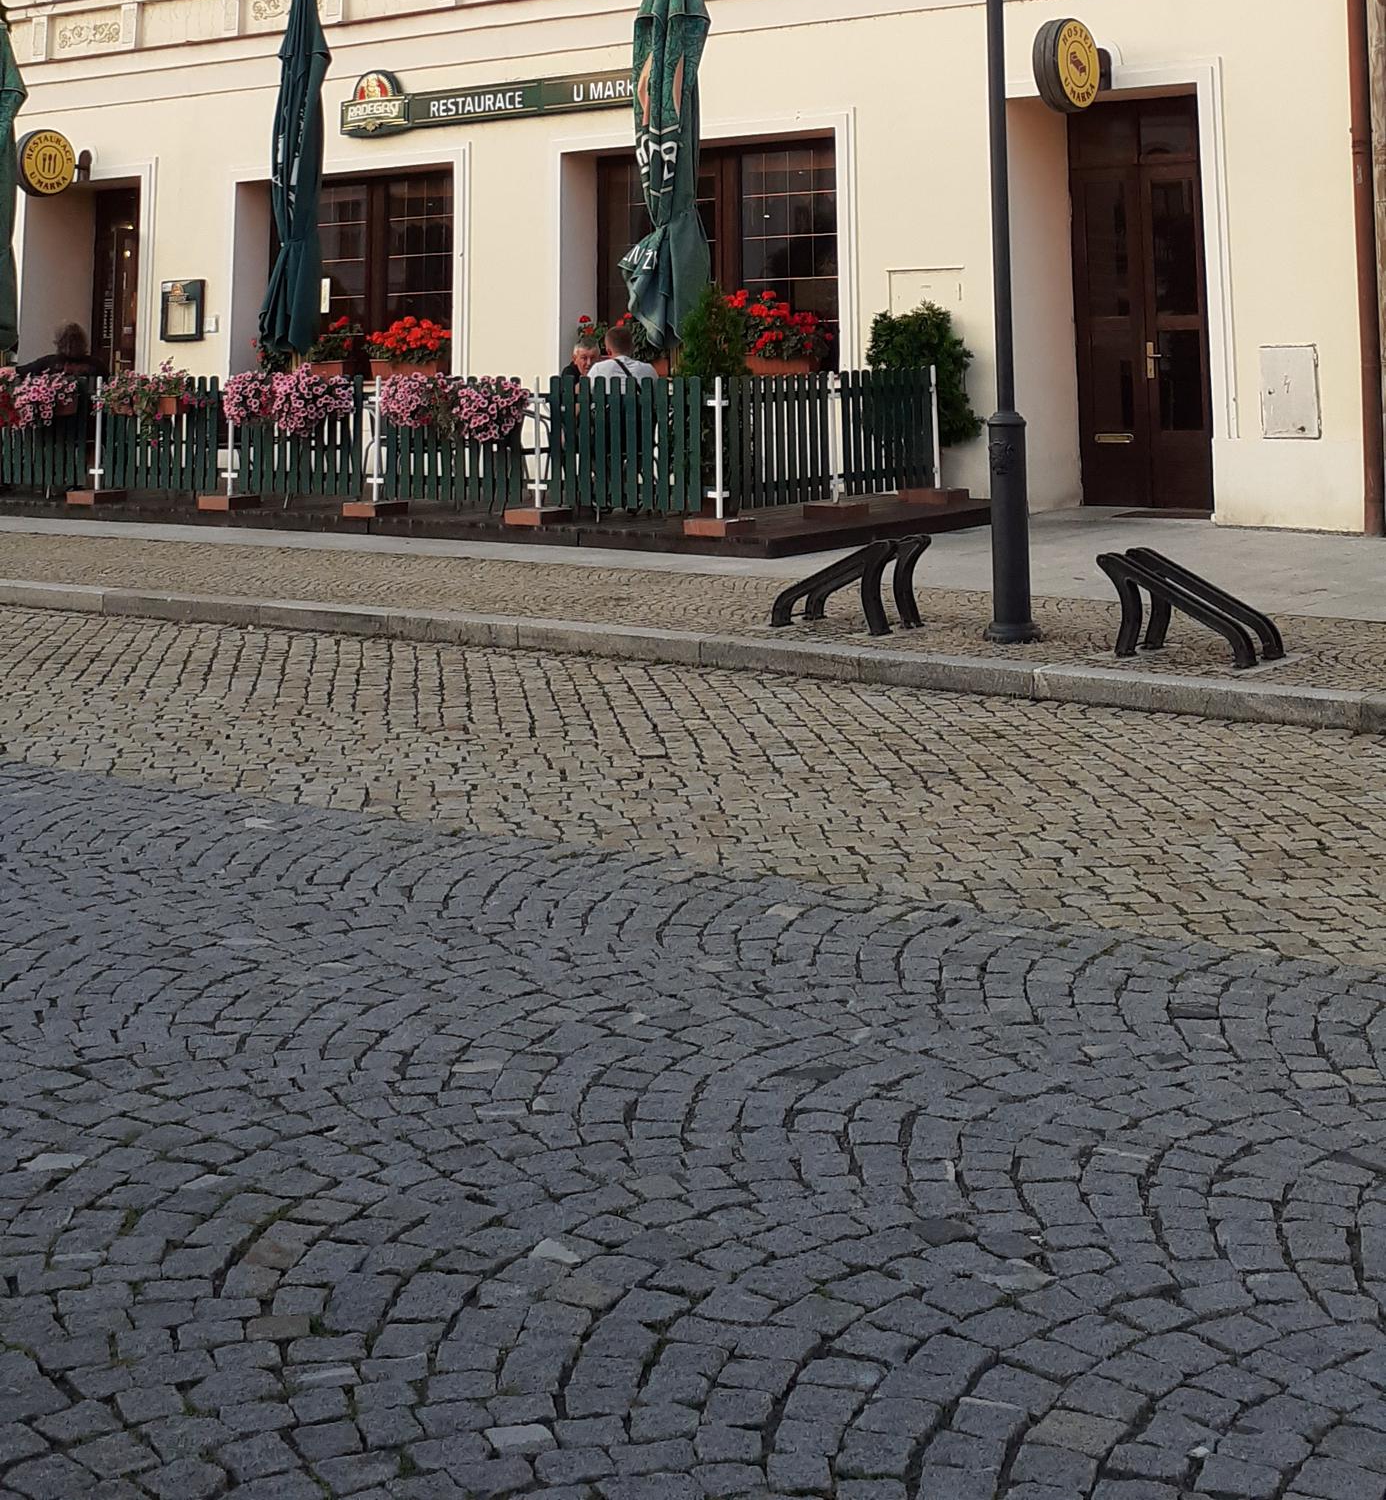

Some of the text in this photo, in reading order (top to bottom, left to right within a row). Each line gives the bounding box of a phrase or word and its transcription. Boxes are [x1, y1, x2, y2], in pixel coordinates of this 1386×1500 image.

[1062, 26, 1093, 53] HOSTEL
[430, 79, 635, 117] RESTAURACE U MARK
[1070, 83, 1095, 102] MARKA
[347, 100, 402, 121] RADEGAST
[26, 134, 73, 164] RESTAURACE
[35, 175, 68, 190] MARKA
